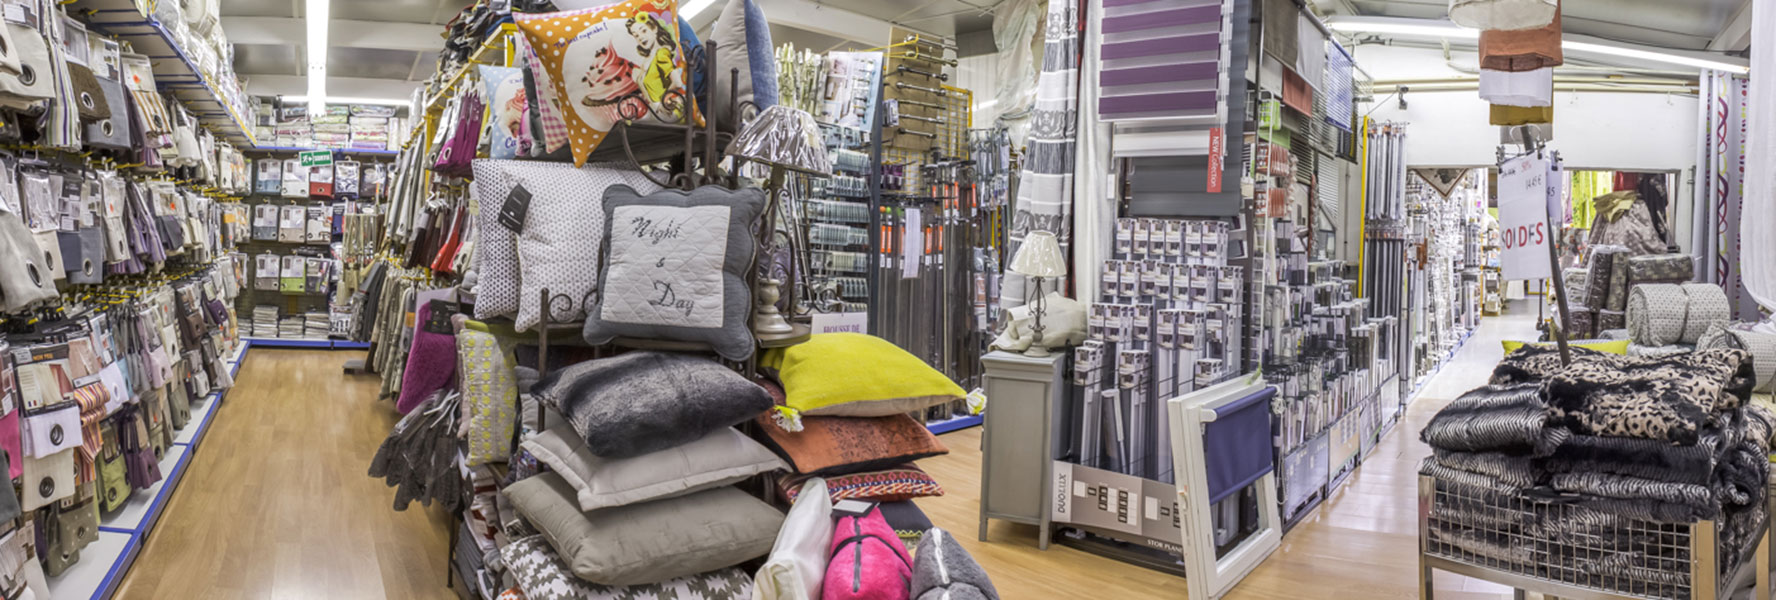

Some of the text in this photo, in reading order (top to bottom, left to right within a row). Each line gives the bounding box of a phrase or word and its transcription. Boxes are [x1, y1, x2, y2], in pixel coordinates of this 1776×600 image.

[1211, 135, 1220, 153] NEW
[631, 216, 680, 246] Night
[646, 280, 695, 317] Day
